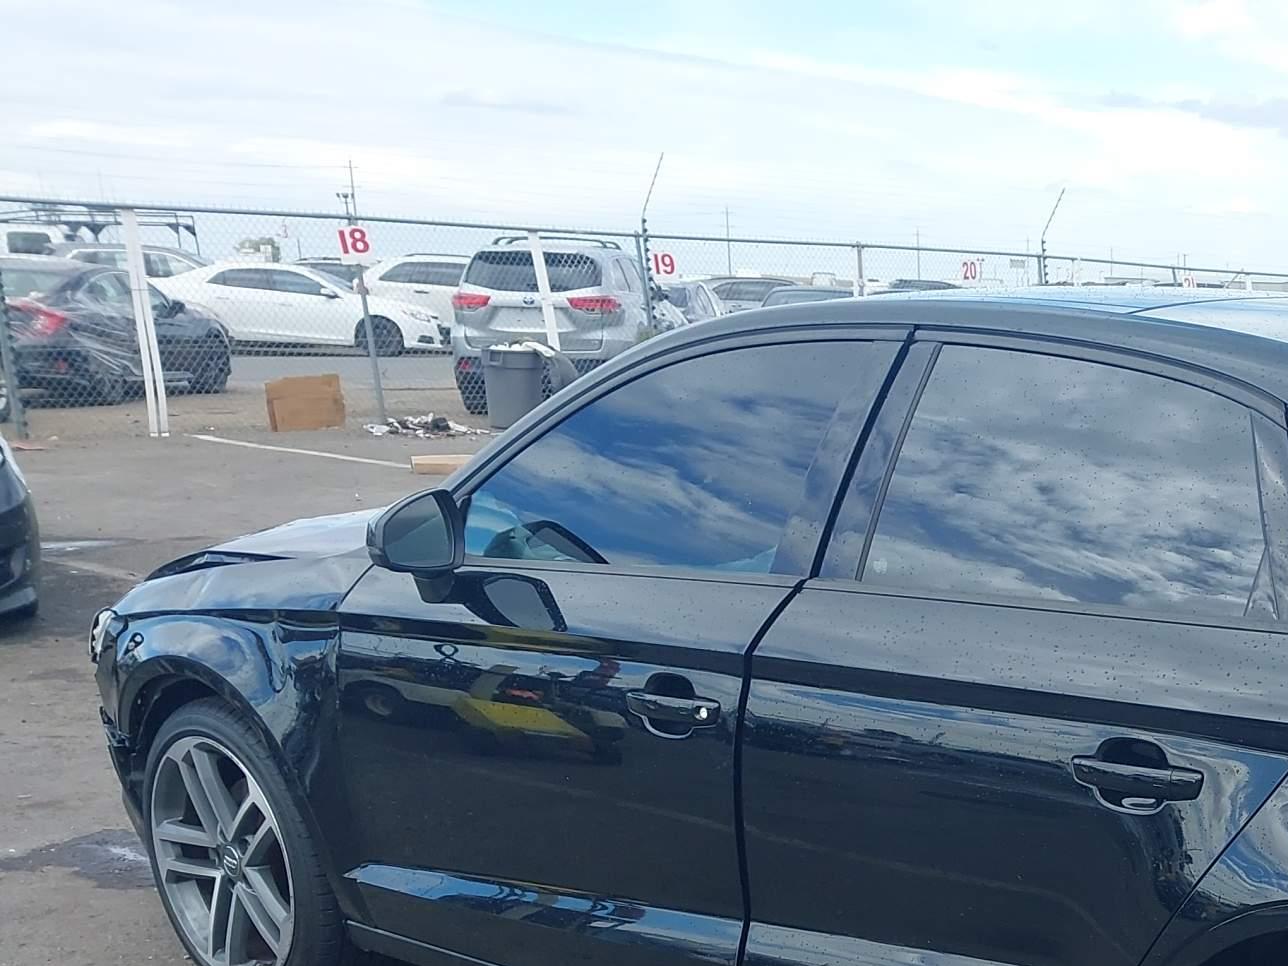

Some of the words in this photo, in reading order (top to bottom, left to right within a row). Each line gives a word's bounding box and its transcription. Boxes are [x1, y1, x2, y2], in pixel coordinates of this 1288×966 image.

[338, 228, 370, 254] 18
[654, 253, 675, 275] 19
[962, 261, 977, 280] 20
